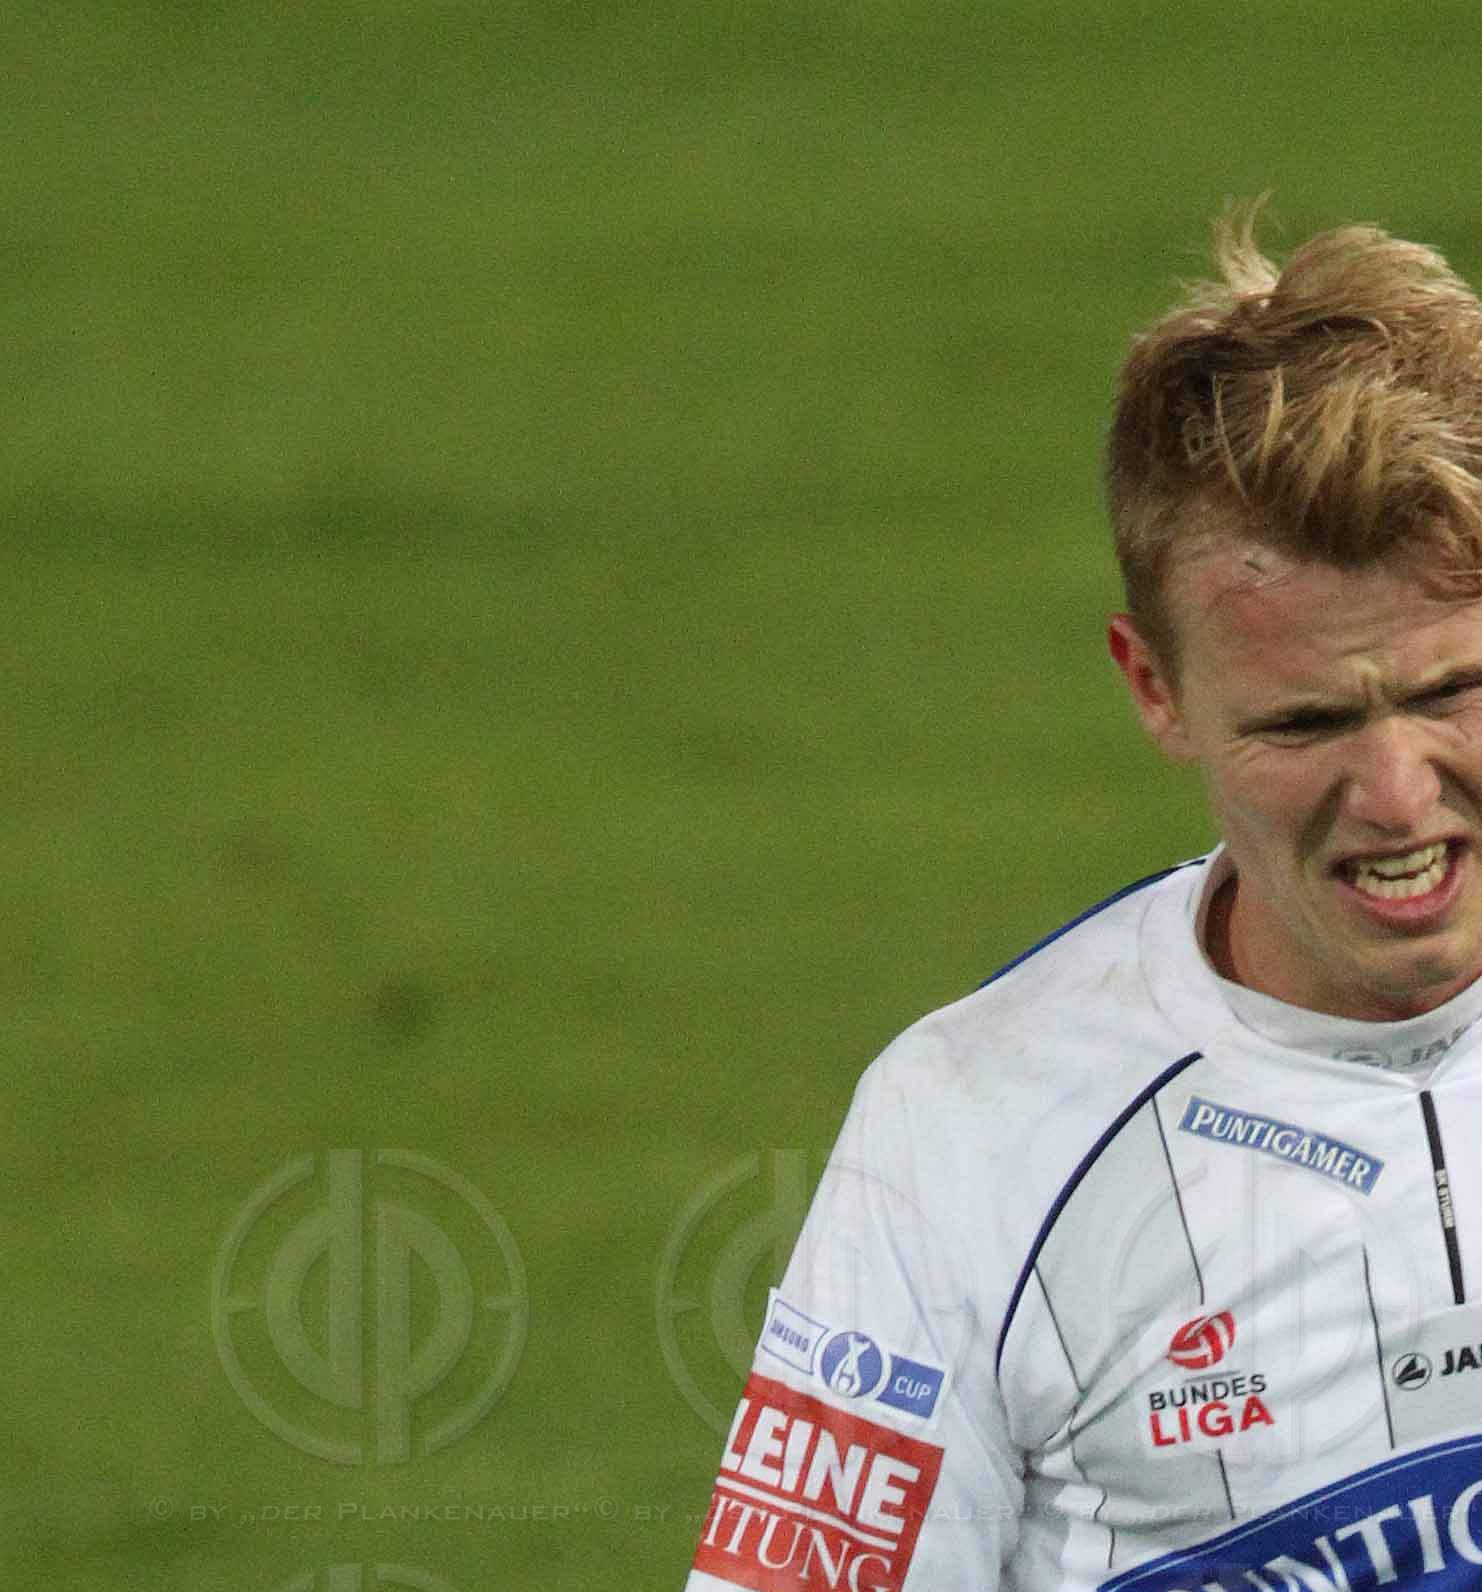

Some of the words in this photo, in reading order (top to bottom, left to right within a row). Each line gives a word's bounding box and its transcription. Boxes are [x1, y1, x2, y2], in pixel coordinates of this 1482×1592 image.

[1191, 1104, 1372, 1191] PUNTIGAMER
[894, 1376, 932, 1400] CUP
[1149, 1374, 1267, 1411] BUNDES
[1151, 1396, 1275, 1447] LIGA
